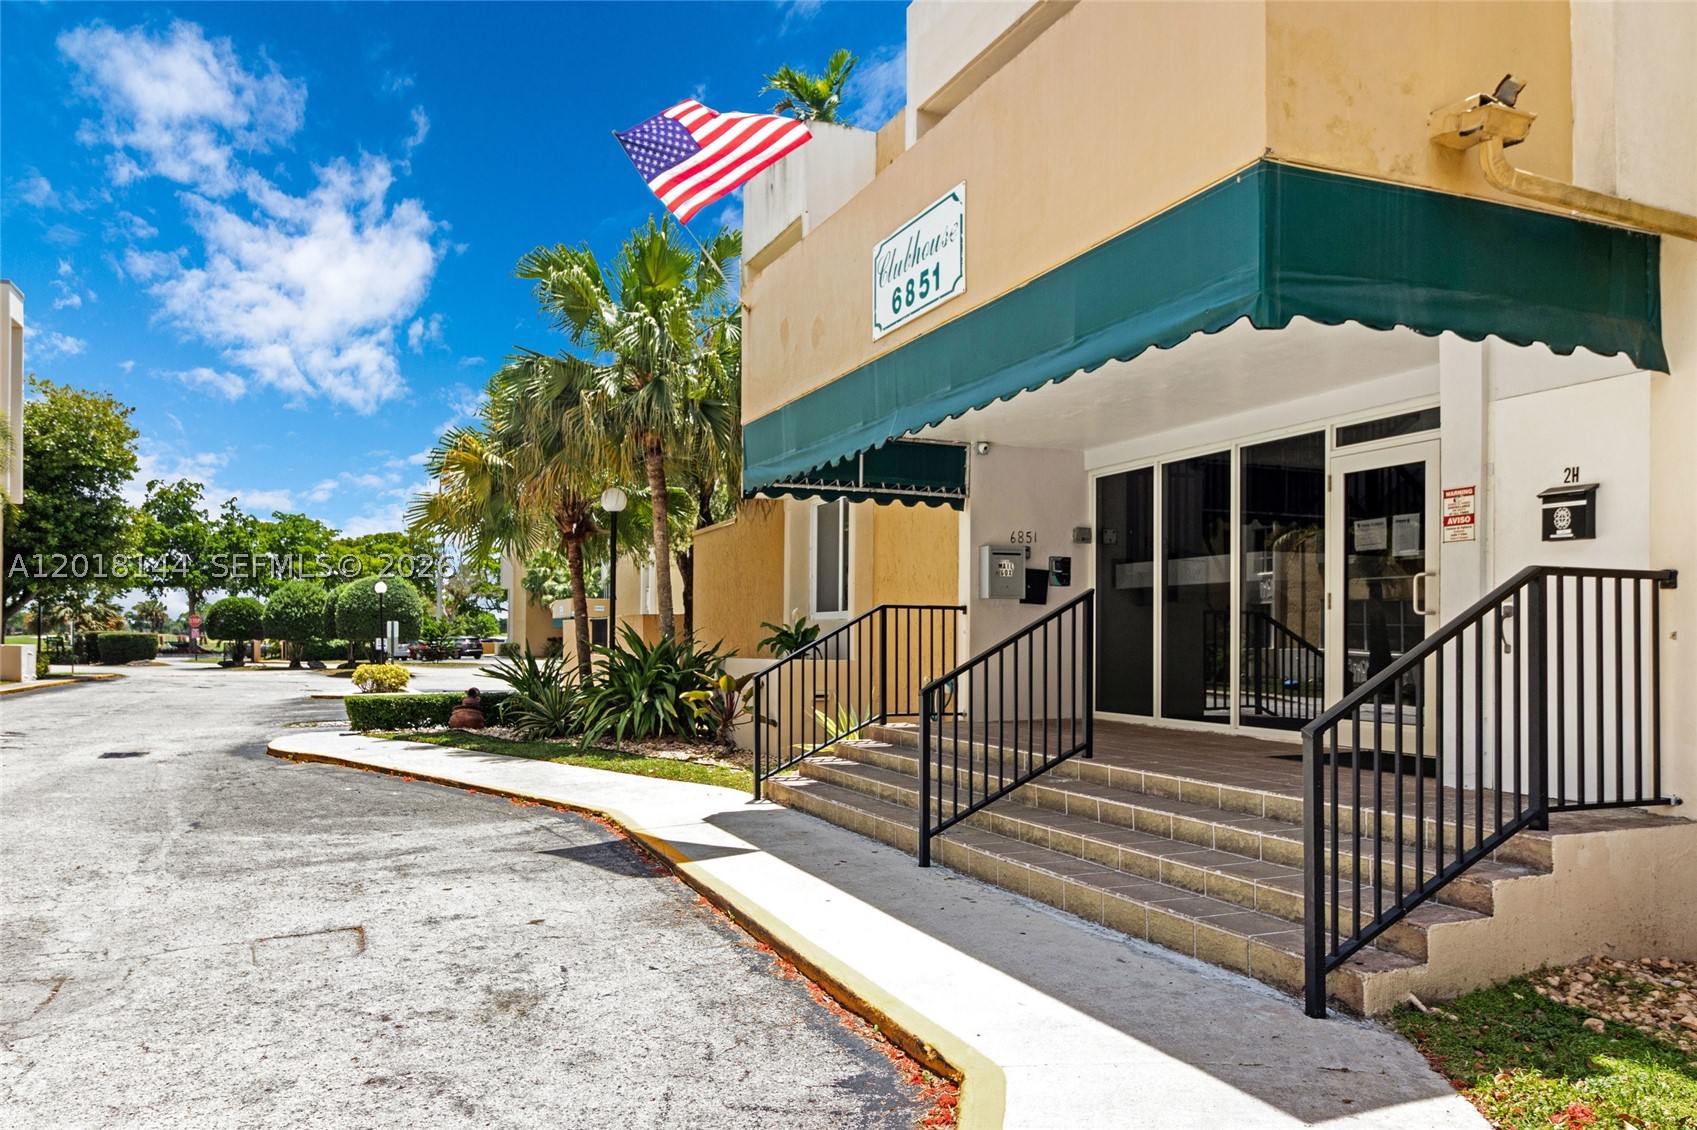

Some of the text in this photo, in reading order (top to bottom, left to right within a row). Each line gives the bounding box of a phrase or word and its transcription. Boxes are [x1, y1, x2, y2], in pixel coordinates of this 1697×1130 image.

[878, 222, 958, 288] Clubhouse
[892, 261, 940, 314] 6851
[1563, 466, 1580, 484] 2H
[1445, 488, 1473, 498] WARNING
[1447, 515, 1471, 525] AVISO
[1010, 530, 1037, 544] 6851
